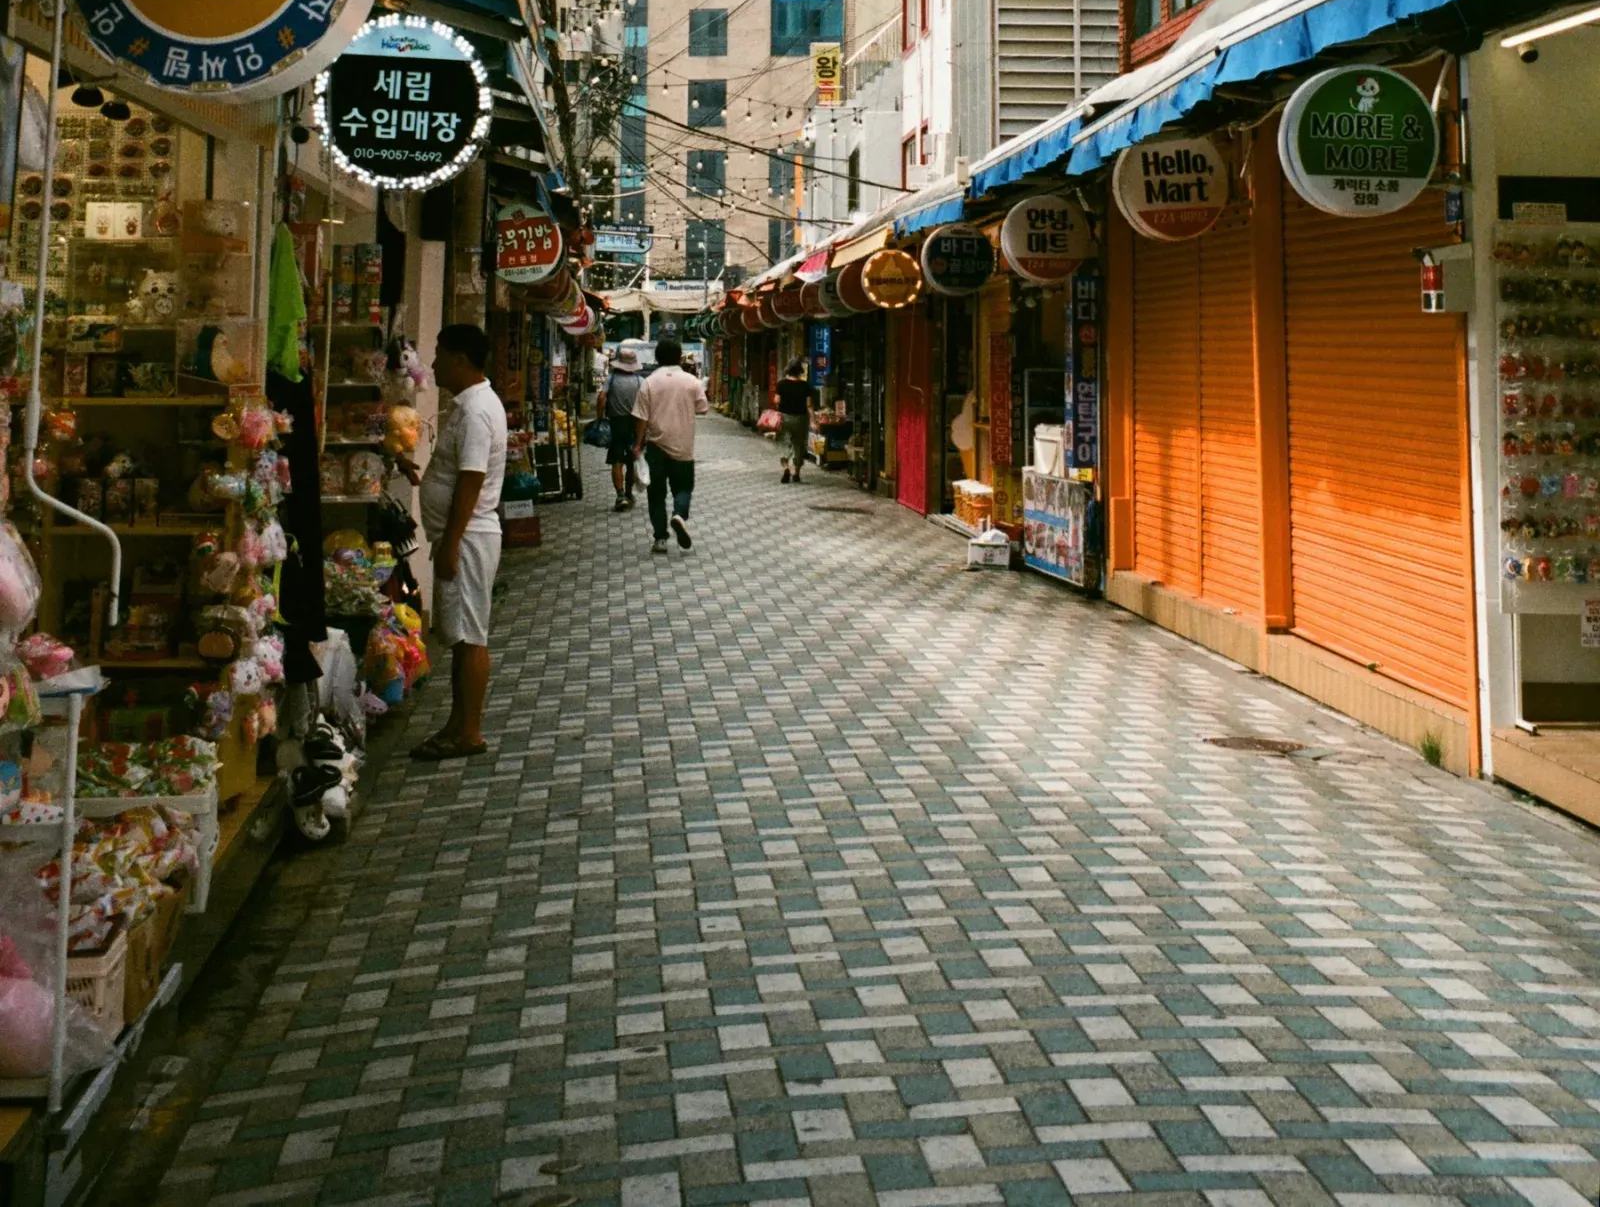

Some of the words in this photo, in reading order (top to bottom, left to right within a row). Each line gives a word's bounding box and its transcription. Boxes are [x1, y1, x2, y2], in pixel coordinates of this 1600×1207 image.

[373, 70, 432, 100] 세림
[339, 107, 462, 144] 수입매장
[1310, 112, 1394, 141] MORE
[1401, 115, 1424, 142] &
[353, 147, 443, 163] 010-9057-5692
[1141, 149, 1215, 177] Hello,
[1324, 144, 1409, 173] MORE
[1145, 178, 1209, 205] Mart
[940, 239, 980, 257] 바다
[1077, 279, 1099, 321] 바다
